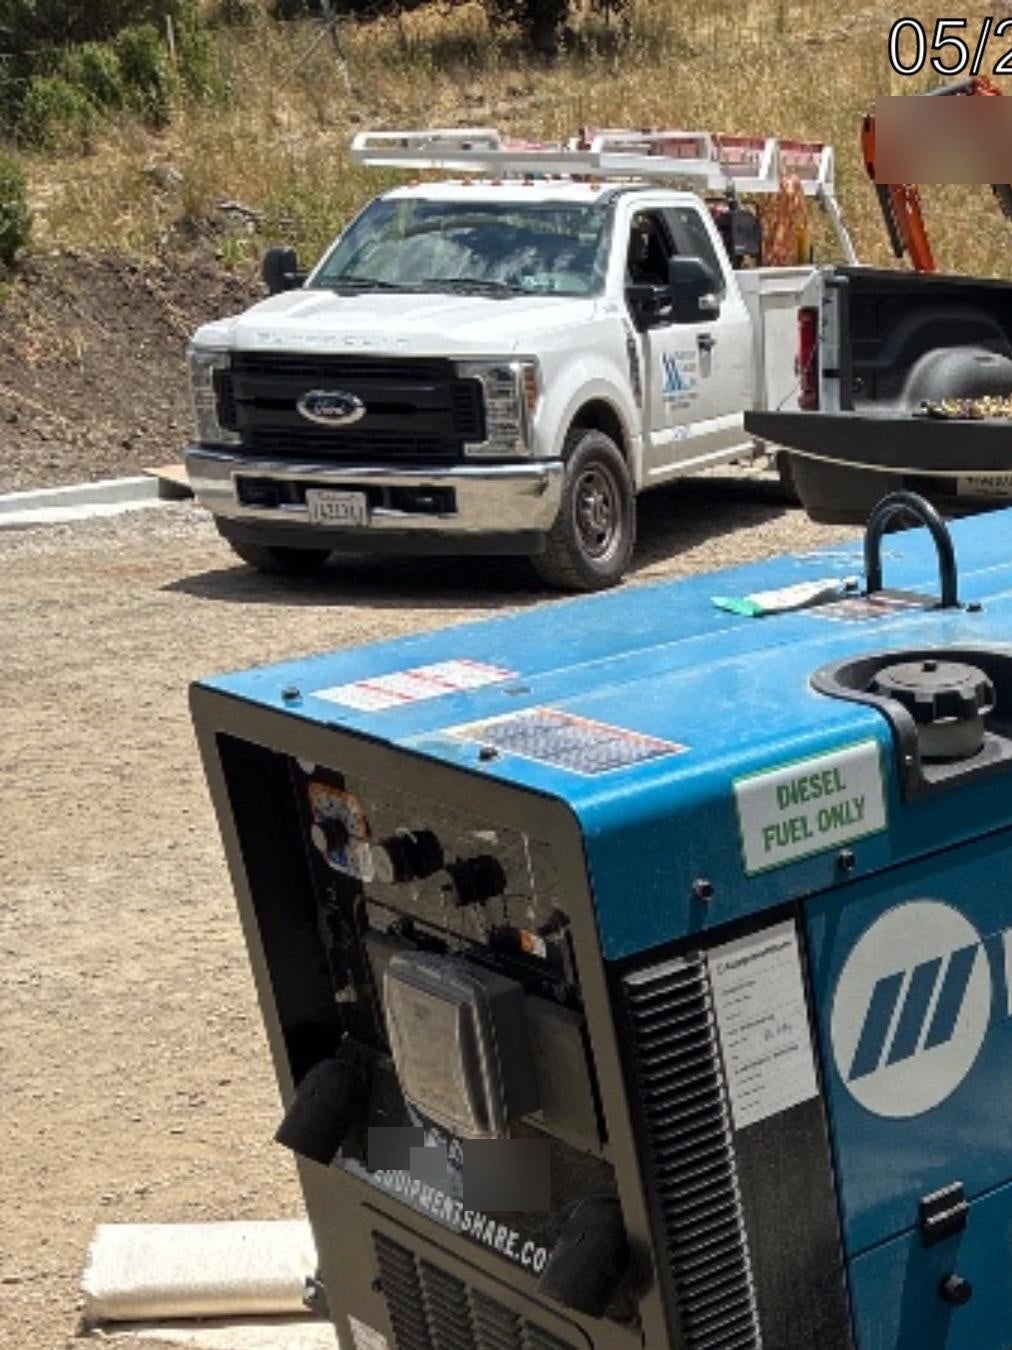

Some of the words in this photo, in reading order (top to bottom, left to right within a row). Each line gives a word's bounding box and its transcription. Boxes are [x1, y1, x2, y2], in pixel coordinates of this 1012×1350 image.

[776, 767, 847, 811] DIESEL
[762, 815, 814, 852] FUEL
[817, 794, 865, 834] ONLY
